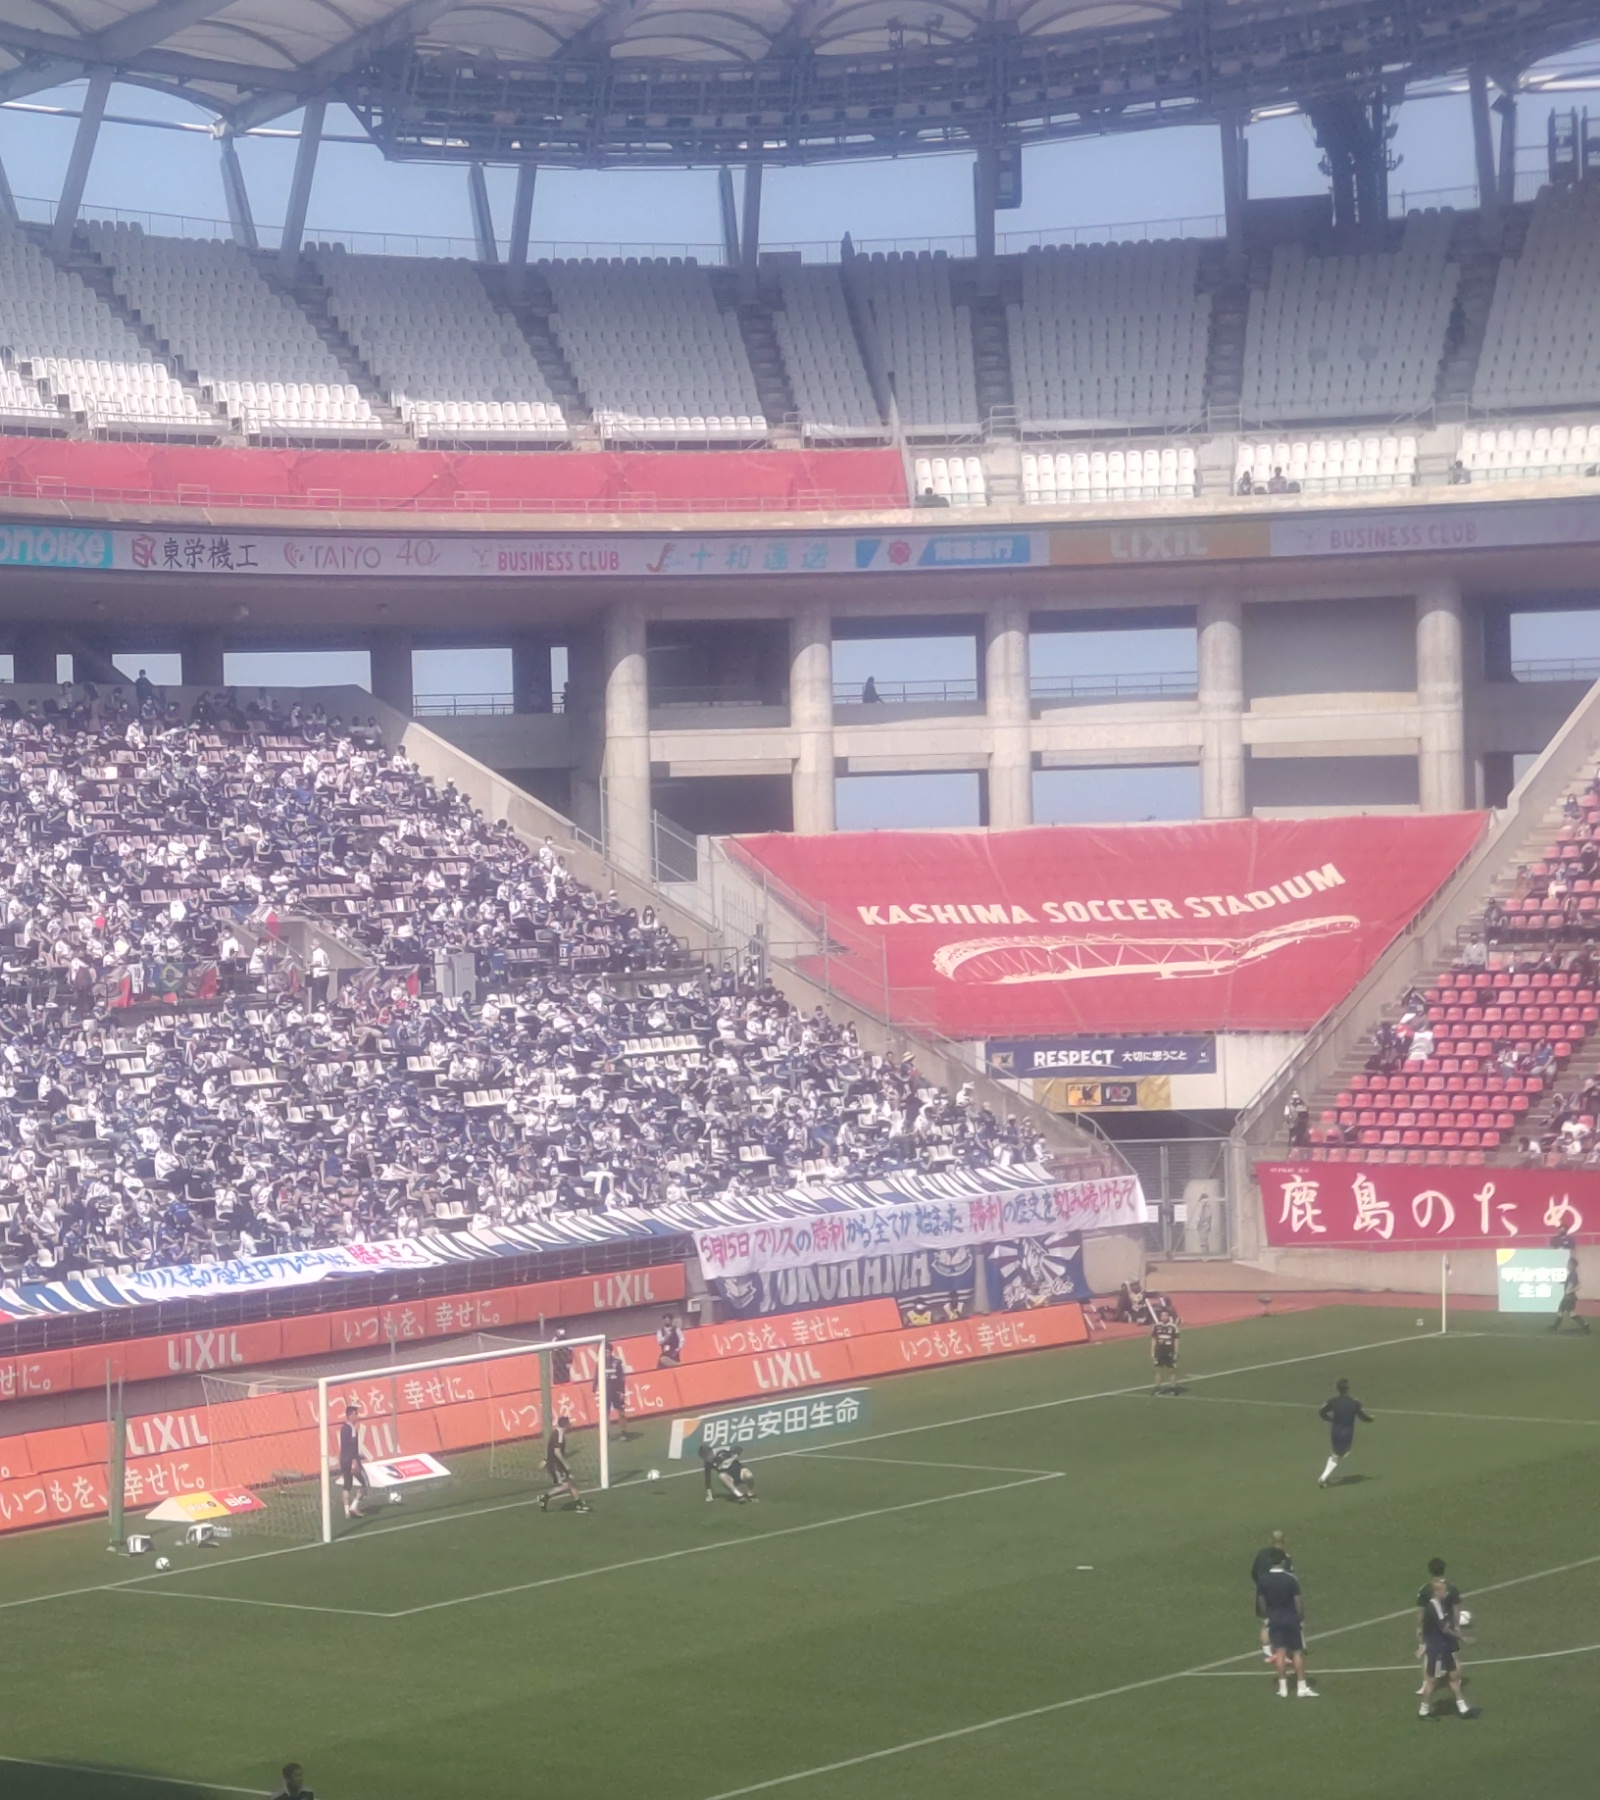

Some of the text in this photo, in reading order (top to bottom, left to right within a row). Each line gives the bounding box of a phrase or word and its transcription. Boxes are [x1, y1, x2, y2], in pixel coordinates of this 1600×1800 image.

[162, 536, 258, 569] 東栄機工
[1110, 529, 1208, 559] LIXIL
[1331, 523, 1477, 549] BUSINESS CLUB
[311, 545, 382, 569] TAIYO
[498, 551, 620, 571] BUSINESS CLUB
[857, 863, 1346, 926] KASHIMA SOCCER STADIUM
[1034, 1050, 1114, 1066] RESPECT
[1122, 1051, 1187, 1062] 大切に思うこと
[1279, 1173, 1583, 1240] 鹿島のため
[593, 1273, 654, 1307] LIXIL
[760, 1251, 931, 1312] YOKOHAMA
[167, 1330, 243, 1370] LIXIL
[752, 1350, 821, 1389] LIXIL
[127, 1414, 209, 1456] LIXIL
[704, 1397, 860, 1447] 明治安田生命
